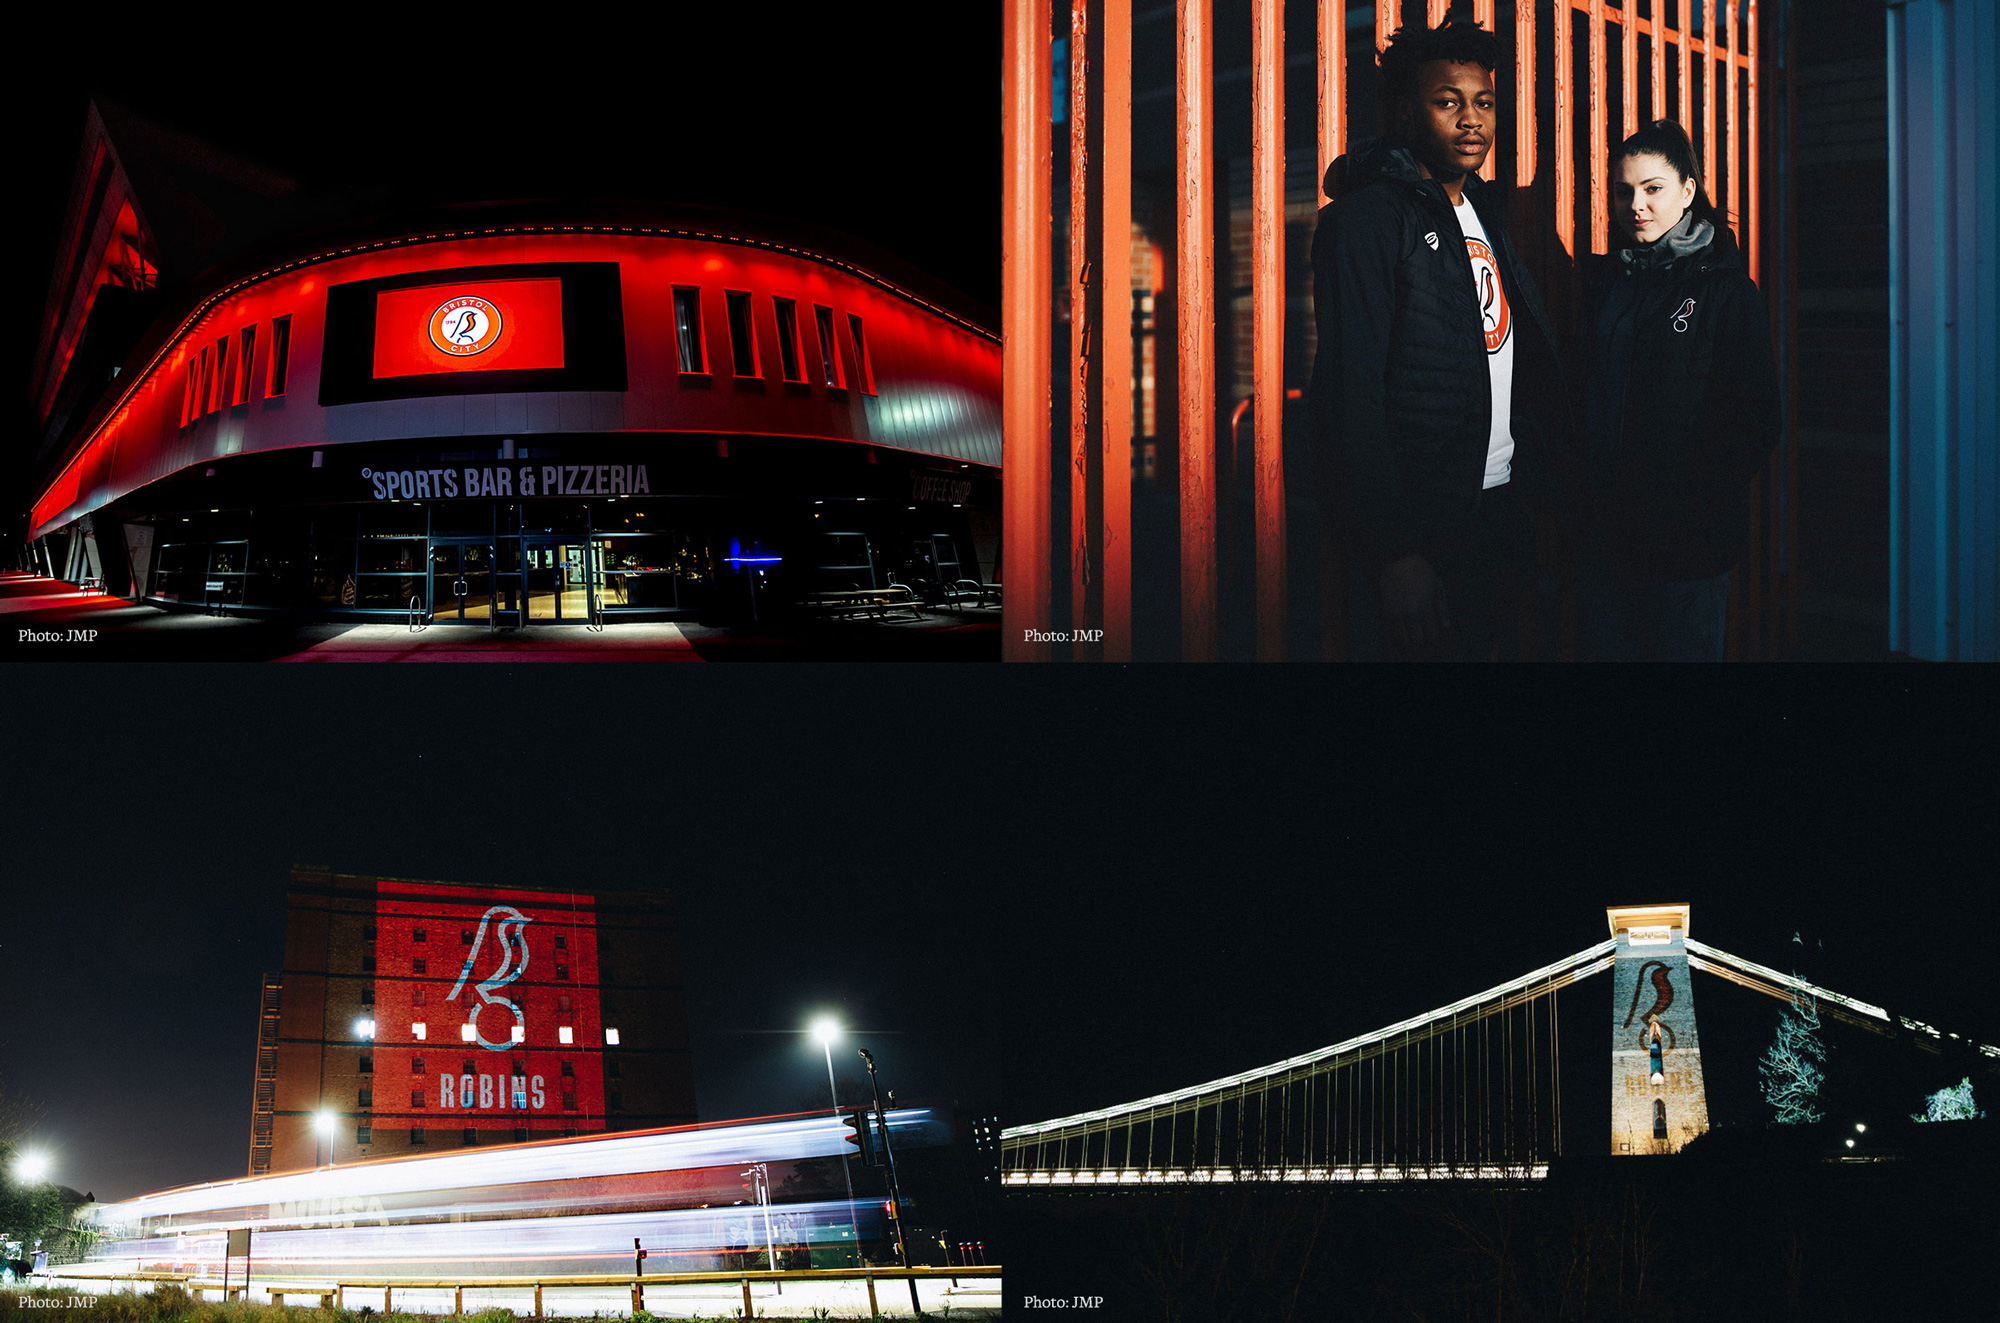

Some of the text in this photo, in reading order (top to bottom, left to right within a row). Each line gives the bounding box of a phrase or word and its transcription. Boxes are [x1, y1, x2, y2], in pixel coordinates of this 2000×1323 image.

[1466, 243, 1498, 273] RISTOL
[442, 299, 488, 314] BRISTOL
[450, 342, 480, 353] CITY
[1485, 330, 1500, 346] ITY
[372, 464, 650, 500] SPORTS BAR & PIZZERIA
[912, 475, 972, 504] COFFEE SHOP
[440, 1073, 545, 1109] ROBINS
[1625, 1069, 1696, 1097] ROINS
